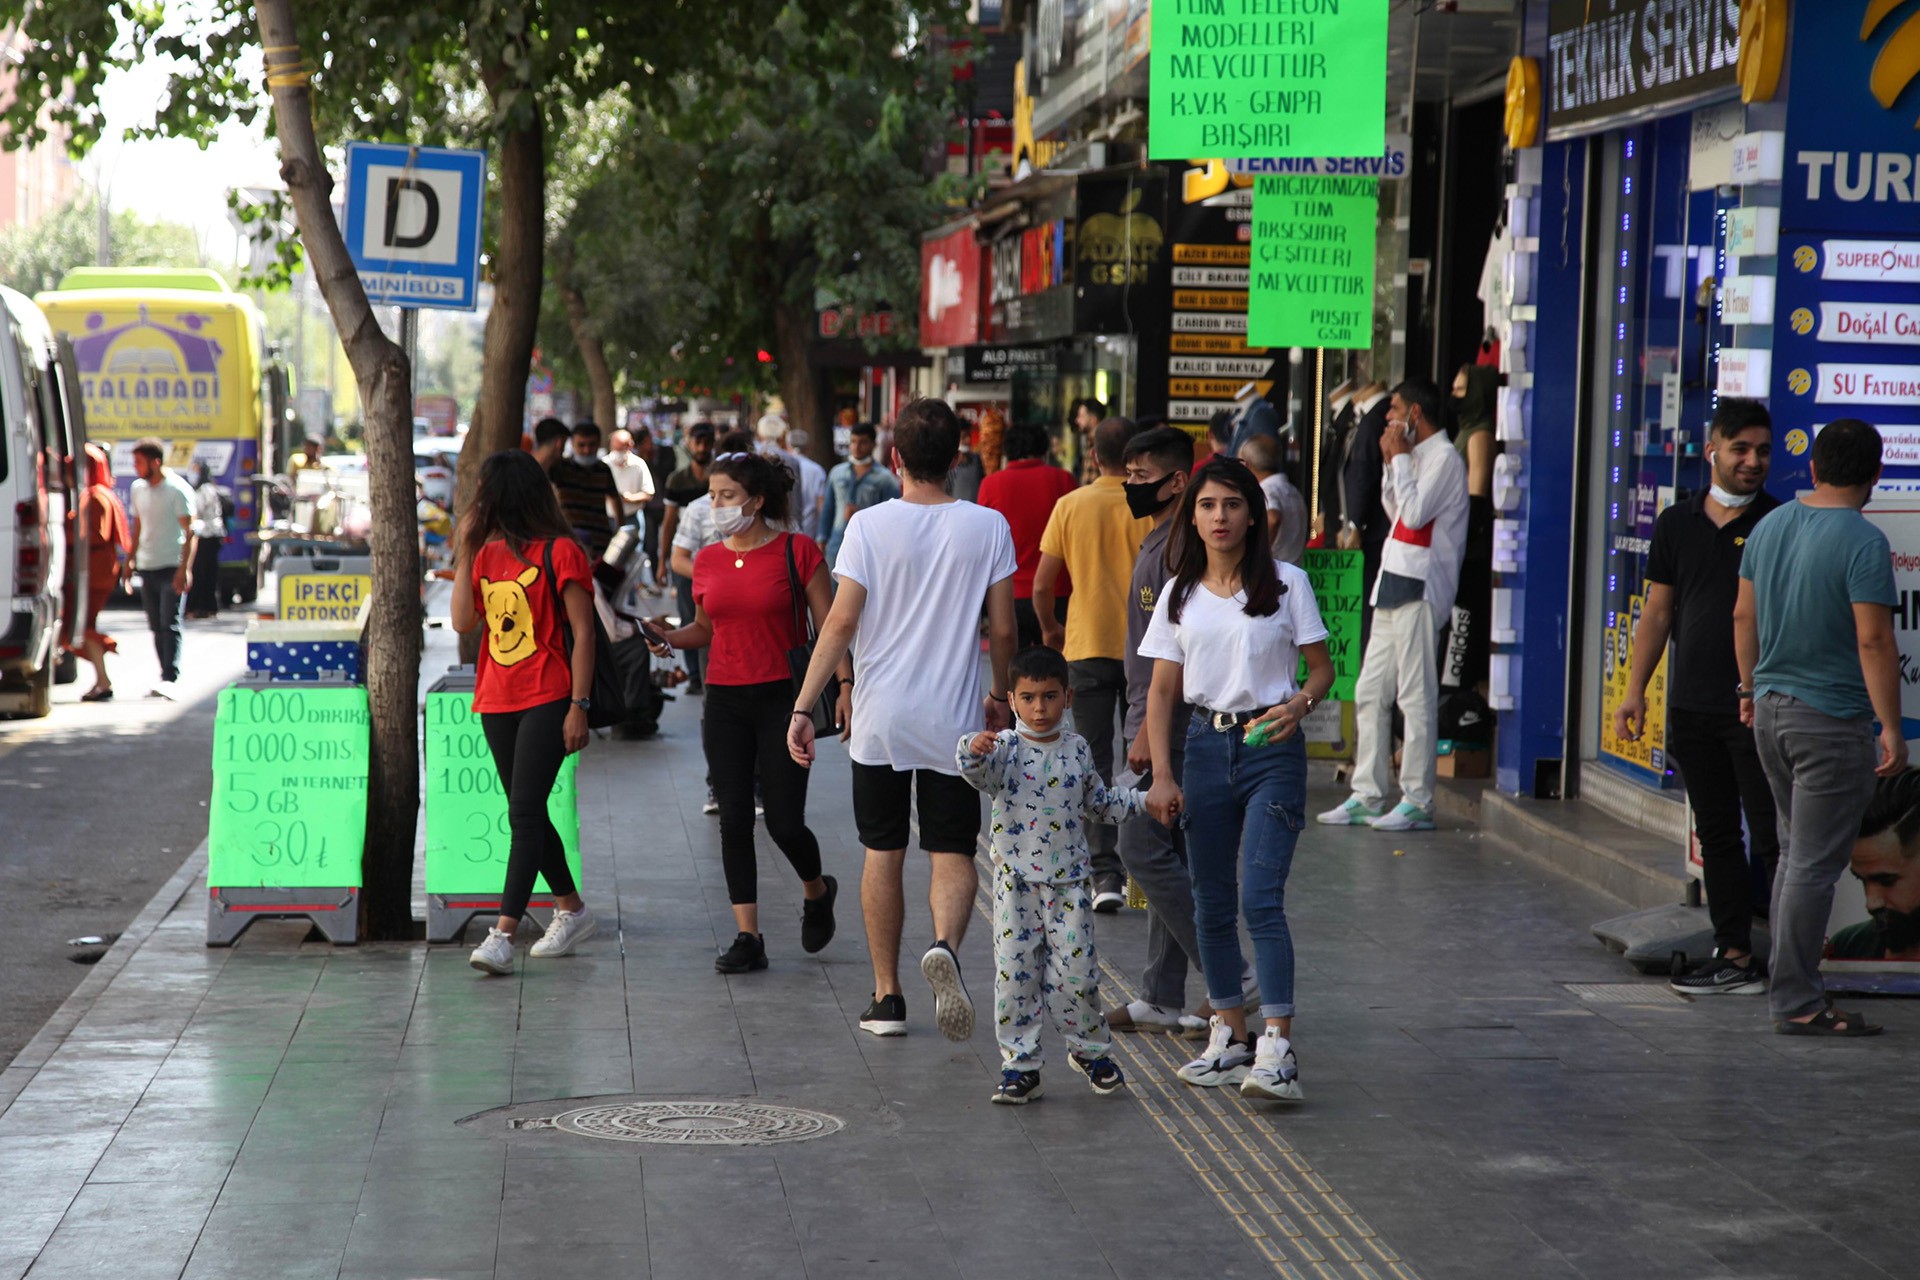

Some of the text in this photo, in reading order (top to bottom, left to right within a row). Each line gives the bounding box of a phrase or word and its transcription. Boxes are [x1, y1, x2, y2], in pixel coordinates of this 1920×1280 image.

[1170, 53, 1327, 79] MEVCUTTUR
[1249, 89, 1322, 115] GENPA
[1201, 122, 1291, 149] BAŞARI
[384, 177, 440, 248] D
[361, 275, 456, 295] MİNİBÜS
[1257, 272, 1364, 295] MEVCUTTUR
[1833, 372, 1857, 395] SU
[295, 578, 359, 603] İPEKÇİ
[1451, 611, 1471, 677] adidas
[223, 692, 305, 725] 1000
[222, 732, 297, 763] 1000
[228, 772, 300, 814] 5 GB
[281, 775, 370, 791] INTERNET
[251, 820, 308, 867] 30
